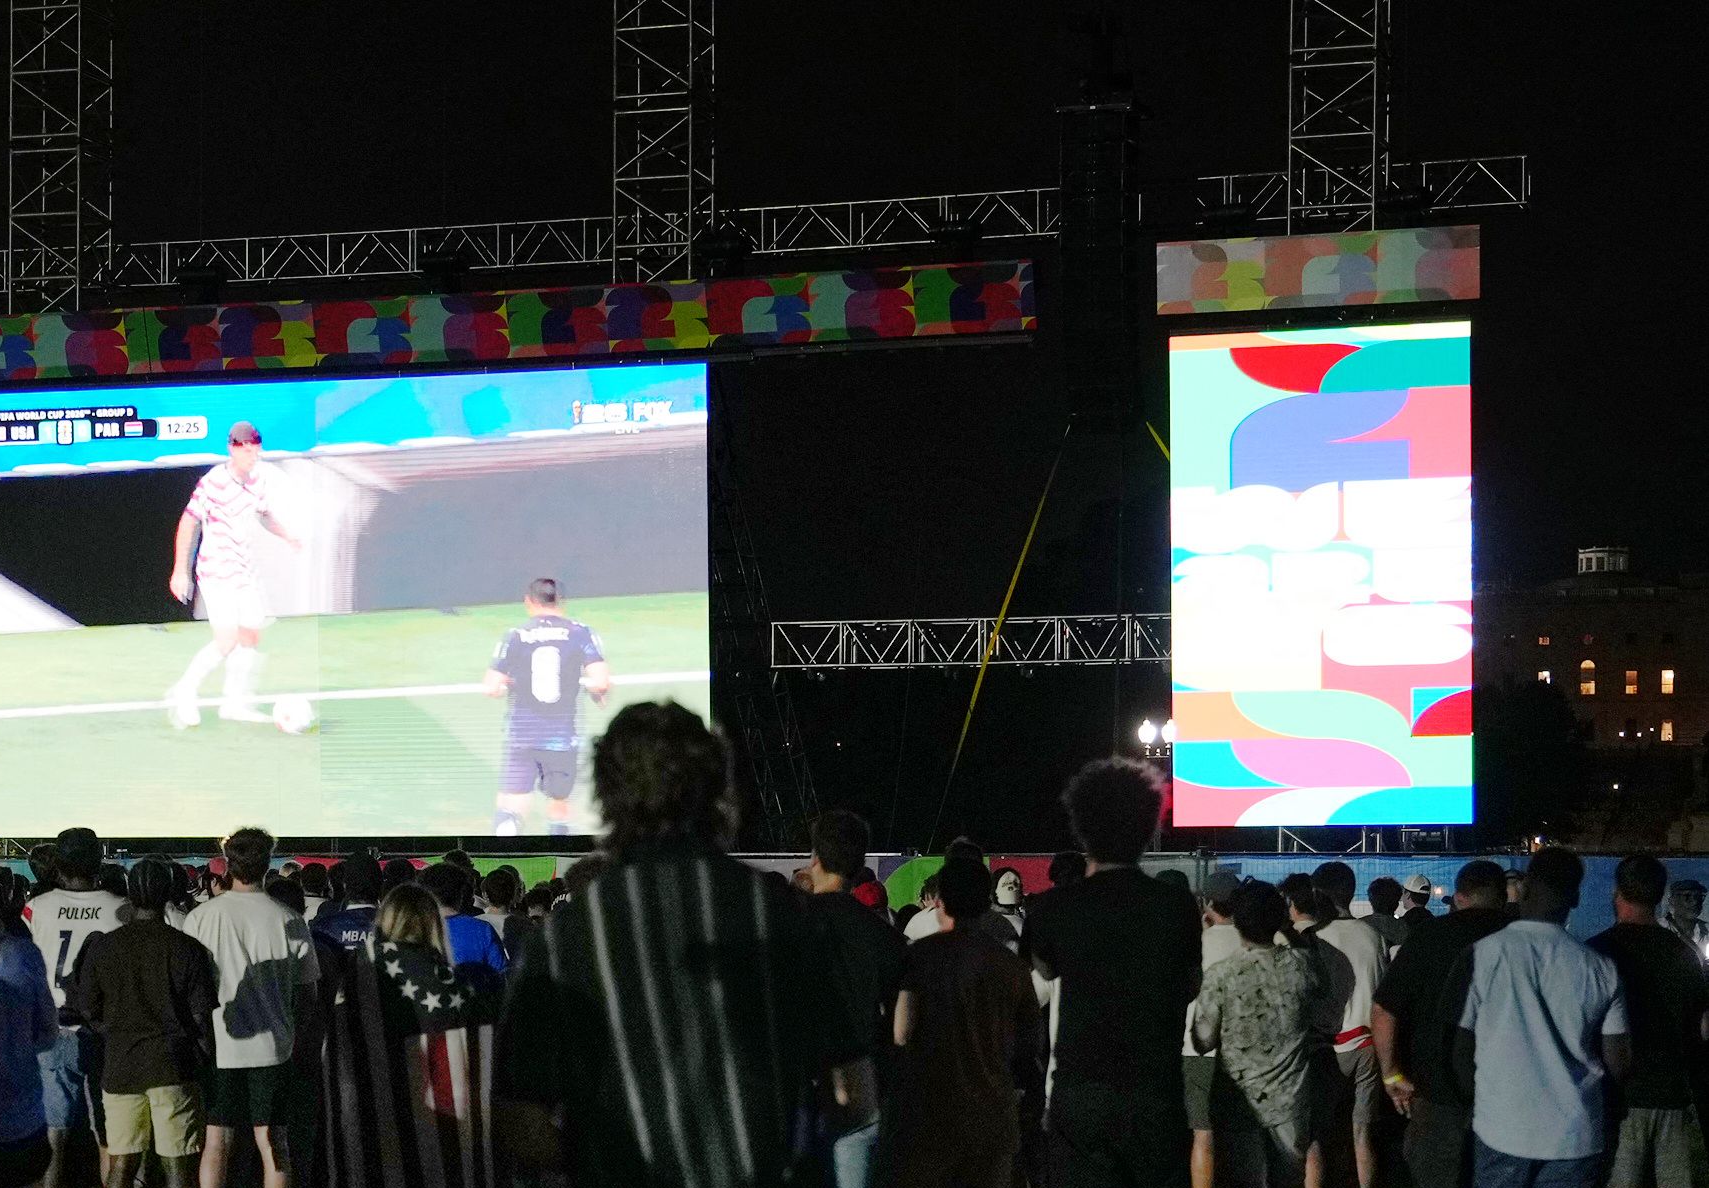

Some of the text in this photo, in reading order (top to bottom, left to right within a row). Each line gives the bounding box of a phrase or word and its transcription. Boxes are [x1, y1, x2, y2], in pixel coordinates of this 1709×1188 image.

[15, 411, 47, 421] WORLD
[47, 410, 65, 420] CUP
[96, 408, 126, 418] GROUP
[11, 425, 36, 440] USA
[95, 422, 120, 437] PAR
[168, 423, 199, 434] 12:25
[58, 906, 102, 920] PULISIC
